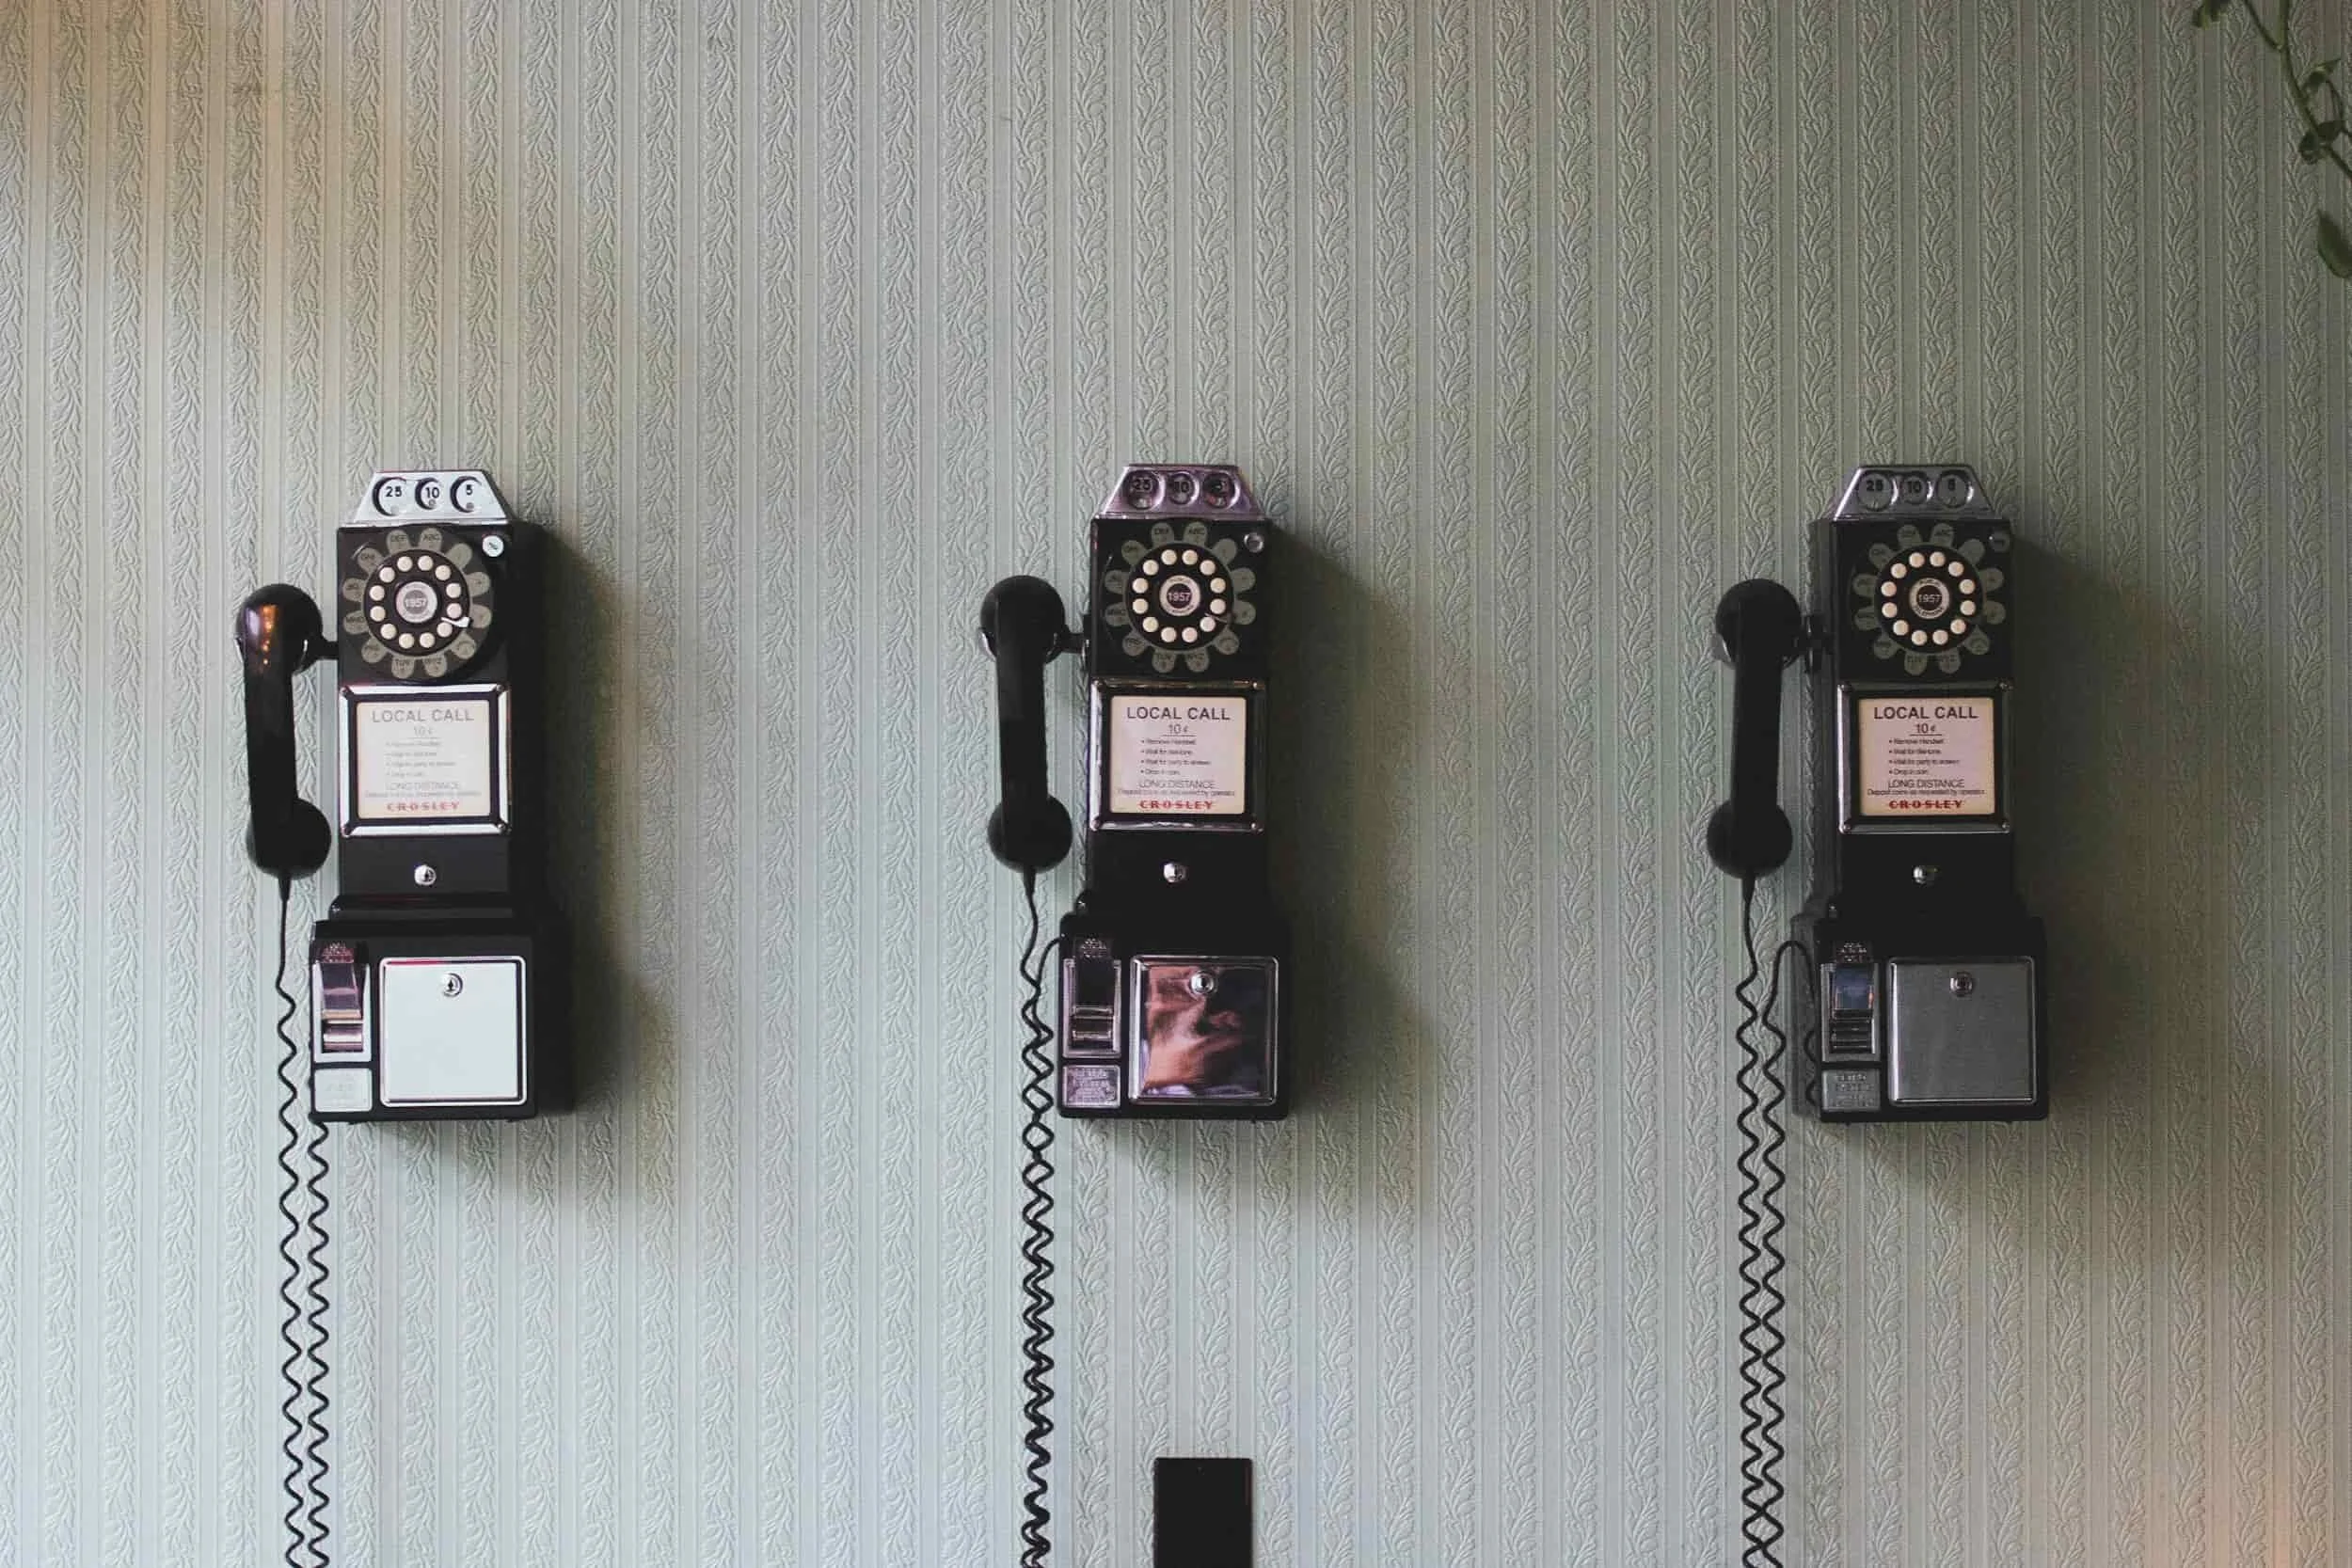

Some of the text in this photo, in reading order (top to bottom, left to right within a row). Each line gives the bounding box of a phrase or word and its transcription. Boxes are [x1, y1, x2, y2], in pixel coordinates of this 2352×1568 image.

[466, 484, 473, 496] 5
[1174, 480, 1189, 492] 10
[1866, 480, 1883, 491] 25
[1907, 481, 1921, 492] 10
[386, 485, 403, 498] 25
[425, 487, 440, 499] 10
[1166, 593, 1191, 602] 1957
[1917, 594, 1941, 603] 1957
[373, 708, 475, 723] LOCAL CALL
[1127, 706, 1231, 721] LOCAL CALL
[1873, 706, 1979, 720] LOCAL CALL
[1139, 780, 1216, 789] LONG DISTANCE
[1888, 779, 1965, 789] LONG DISTANCE
[387, 800, 460, 811] CROSLEY
[1139, 800, 1214, 810] CROSLEY
[1888, 800, 1963, 810] CROSLEY
